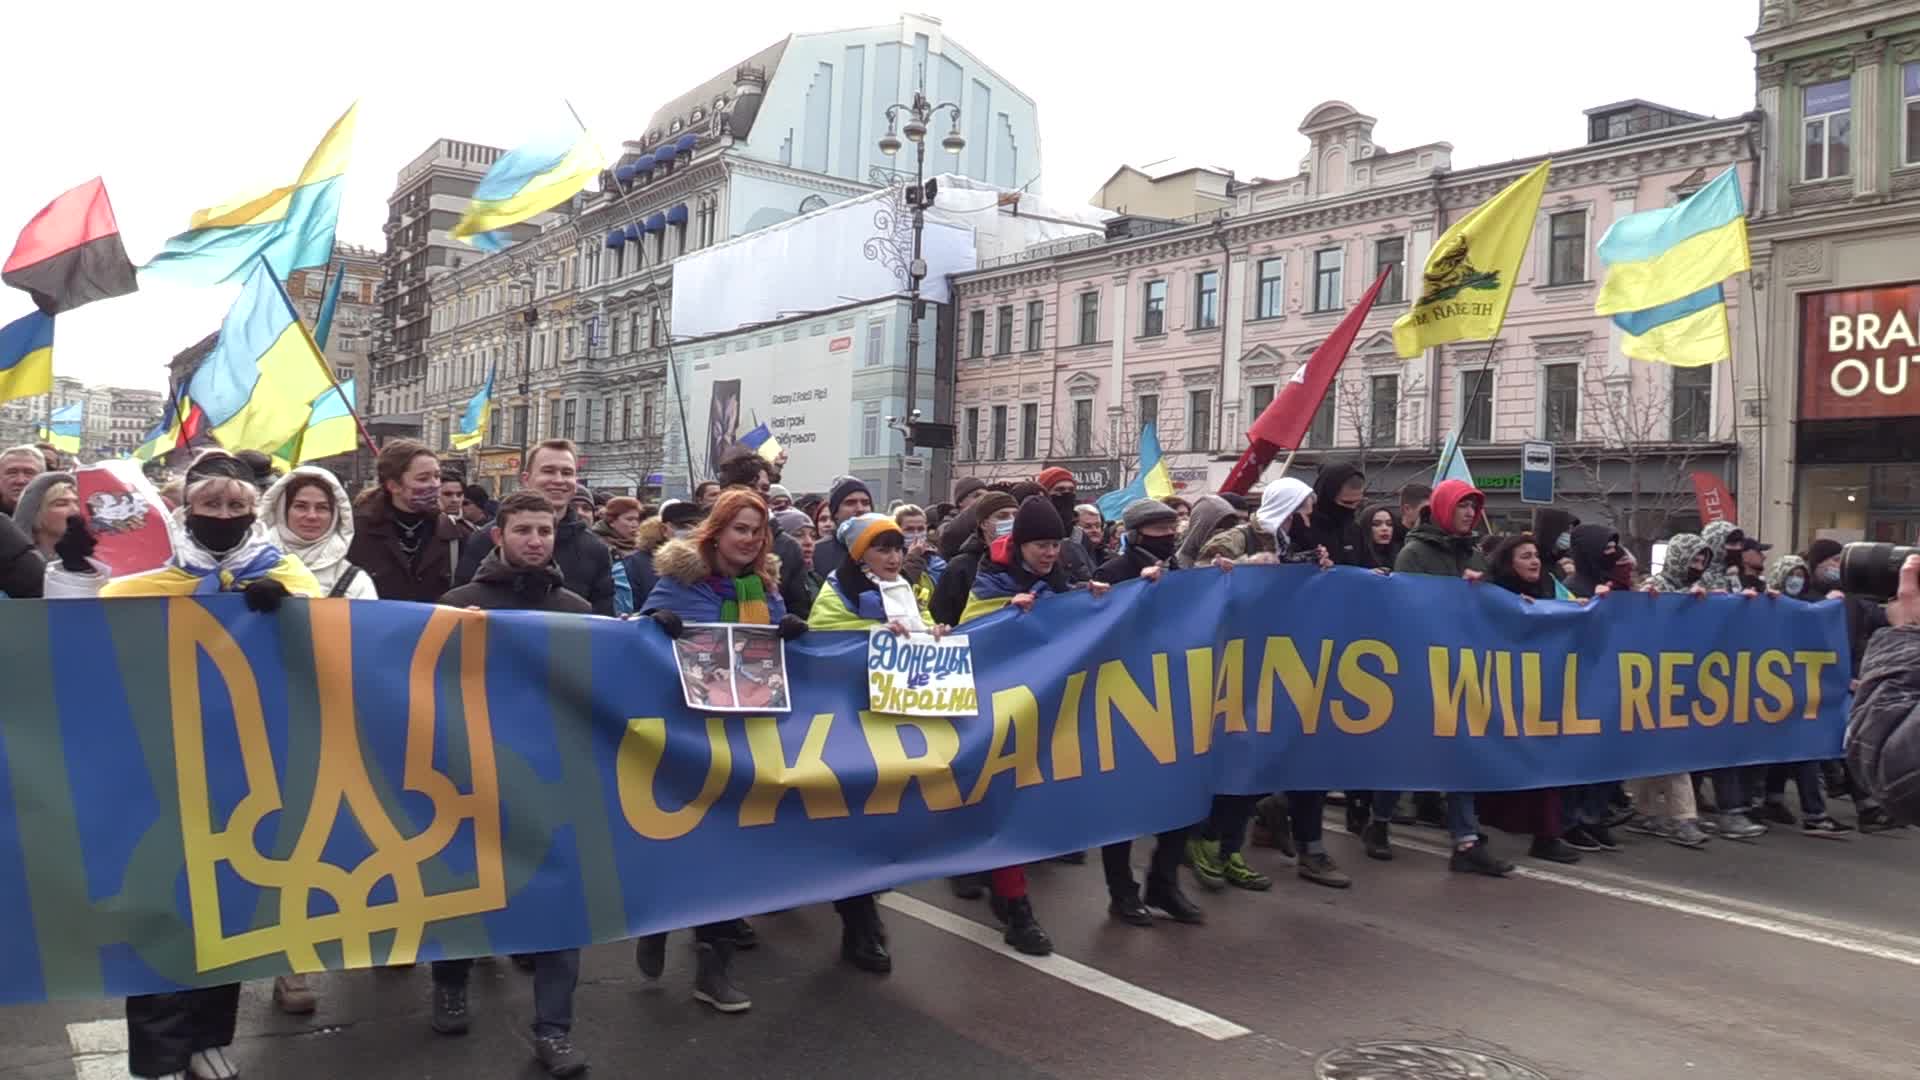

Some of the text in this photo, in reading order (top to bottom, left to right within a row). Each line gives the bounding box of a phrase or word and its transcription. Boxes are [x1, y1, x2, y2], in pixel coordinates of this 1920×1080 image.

[1828, 309, 1920, 352] BRA
[775, 432, 817, 448] айбутнього
[869, 630, 972, 680] Донецьк
[870, 671, 978, 713] Україна
[907, 671, 930, 689] це
[616, 636, 1838, 840] UKRAINIANS WILL RESIST
